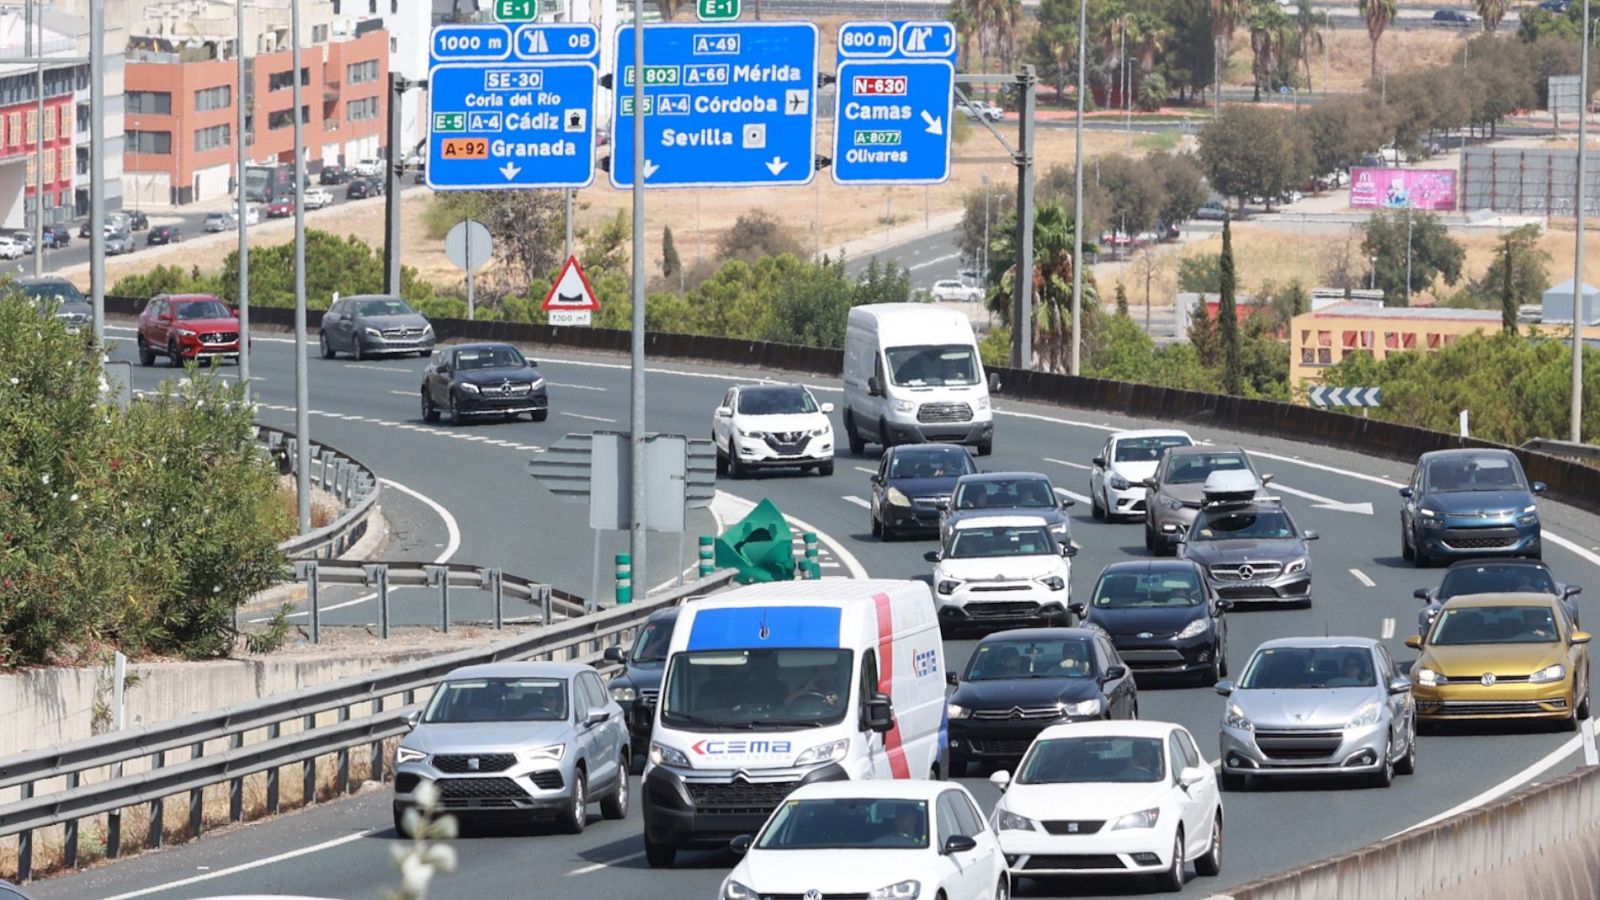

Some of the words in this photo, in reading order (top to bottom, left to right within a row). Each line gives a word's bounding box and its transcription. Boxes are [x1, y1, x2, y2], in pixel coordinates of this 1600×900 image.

[503, 1, 530, 16] E-1
[705, 0, 732, 14] E-1
[440, 36, 481, 50] 1000
[488, 38, 503, 49] m
[697, 37, 737, 52] A-49
[844, 32, 875, 47] 800
[878, 35, 892, 47] m
[943, 32, 950, 47] 1
[488, 73, 541, 88] SE-30
[688, 68, 726, 82] A-66
[733, 64, 801, 82] Mérida
[855, 79, 905, 93] N-630
[465, 93, 503, 107] Coria
[509, 93, 533, 107] del
[537, 92, 561, 106] Río
[660, 97, 688, 112] A-4
[694, 95, 778, 113] Córdoba
[845, 101, 912, 120] Camas
[436, 115, 463, 129] E-5
[471, 115, 500, 130] A-4
[505, 112, 559, 131] Cádiz
[660, 128, 733, 146] Sevilla
[856, 132, 899, 143] A-8077
[445, 142, 486, 156] A-92
[491, 139, 576, 157] Granada
[845, 149, 908, 163] Olivares
